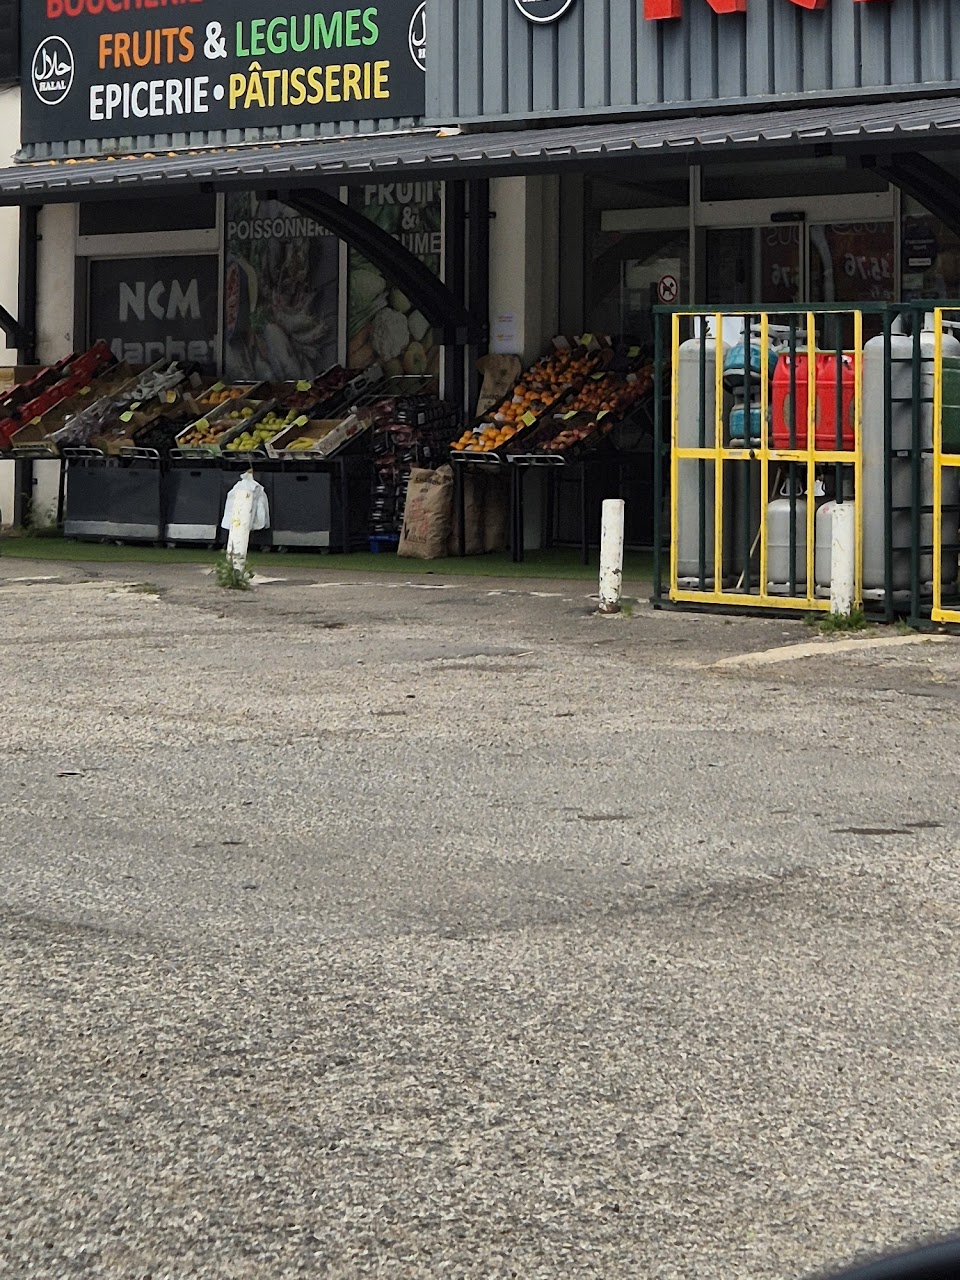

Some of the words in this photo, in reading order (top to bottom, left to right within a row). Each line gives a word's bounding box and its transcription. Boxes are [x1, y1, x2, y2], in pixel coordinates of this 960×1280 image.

[98, 25, 195, 70] FRUITS
[203, 21, 228, 60] &
[235, 8, 378, 57] LEGUMES
[34, 47, 72, 81] حلال
[39, 80, 67, 93] HALAL
[89, 75, 209, 121] EPICERIE
[229, 62, 390, 110] PÂTISSERIE
[118, 278, 202, 323] NCM
